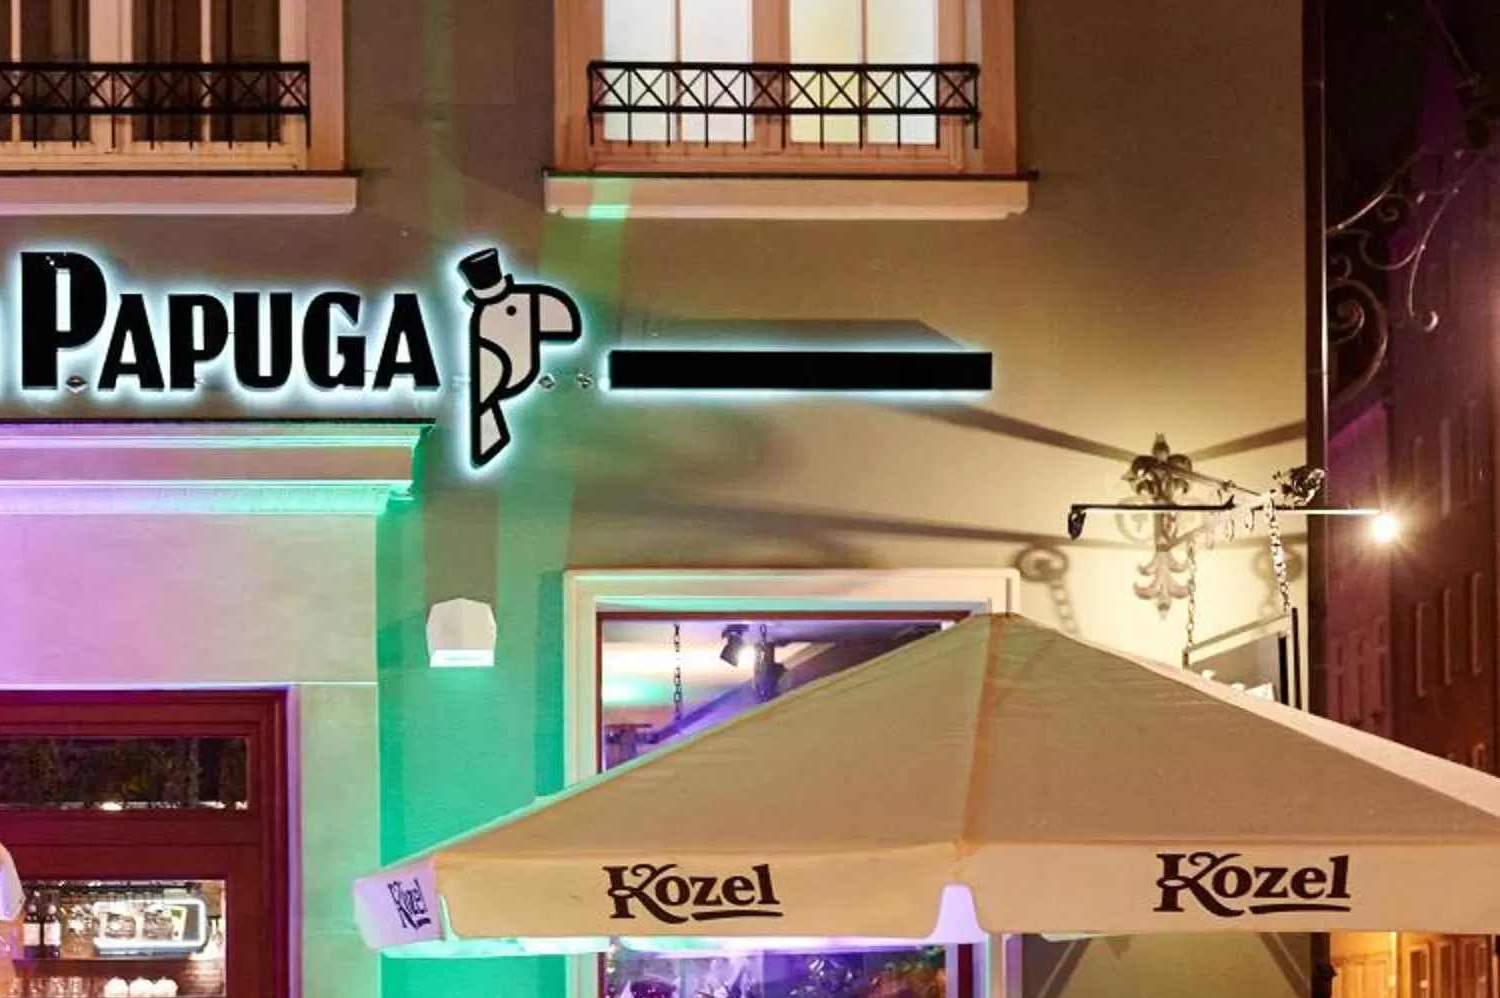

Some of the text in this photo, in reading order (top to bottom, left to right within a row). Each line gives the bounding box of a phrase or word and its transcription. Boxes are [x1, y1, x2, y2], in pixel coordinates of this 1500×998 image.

[19, 250, 442, 392] PAPUGA
[387, 877, 432, 931] Kozel
[601, 863, 785, 925] Kozel
[1152, 851, 1352, 918] Kozel
